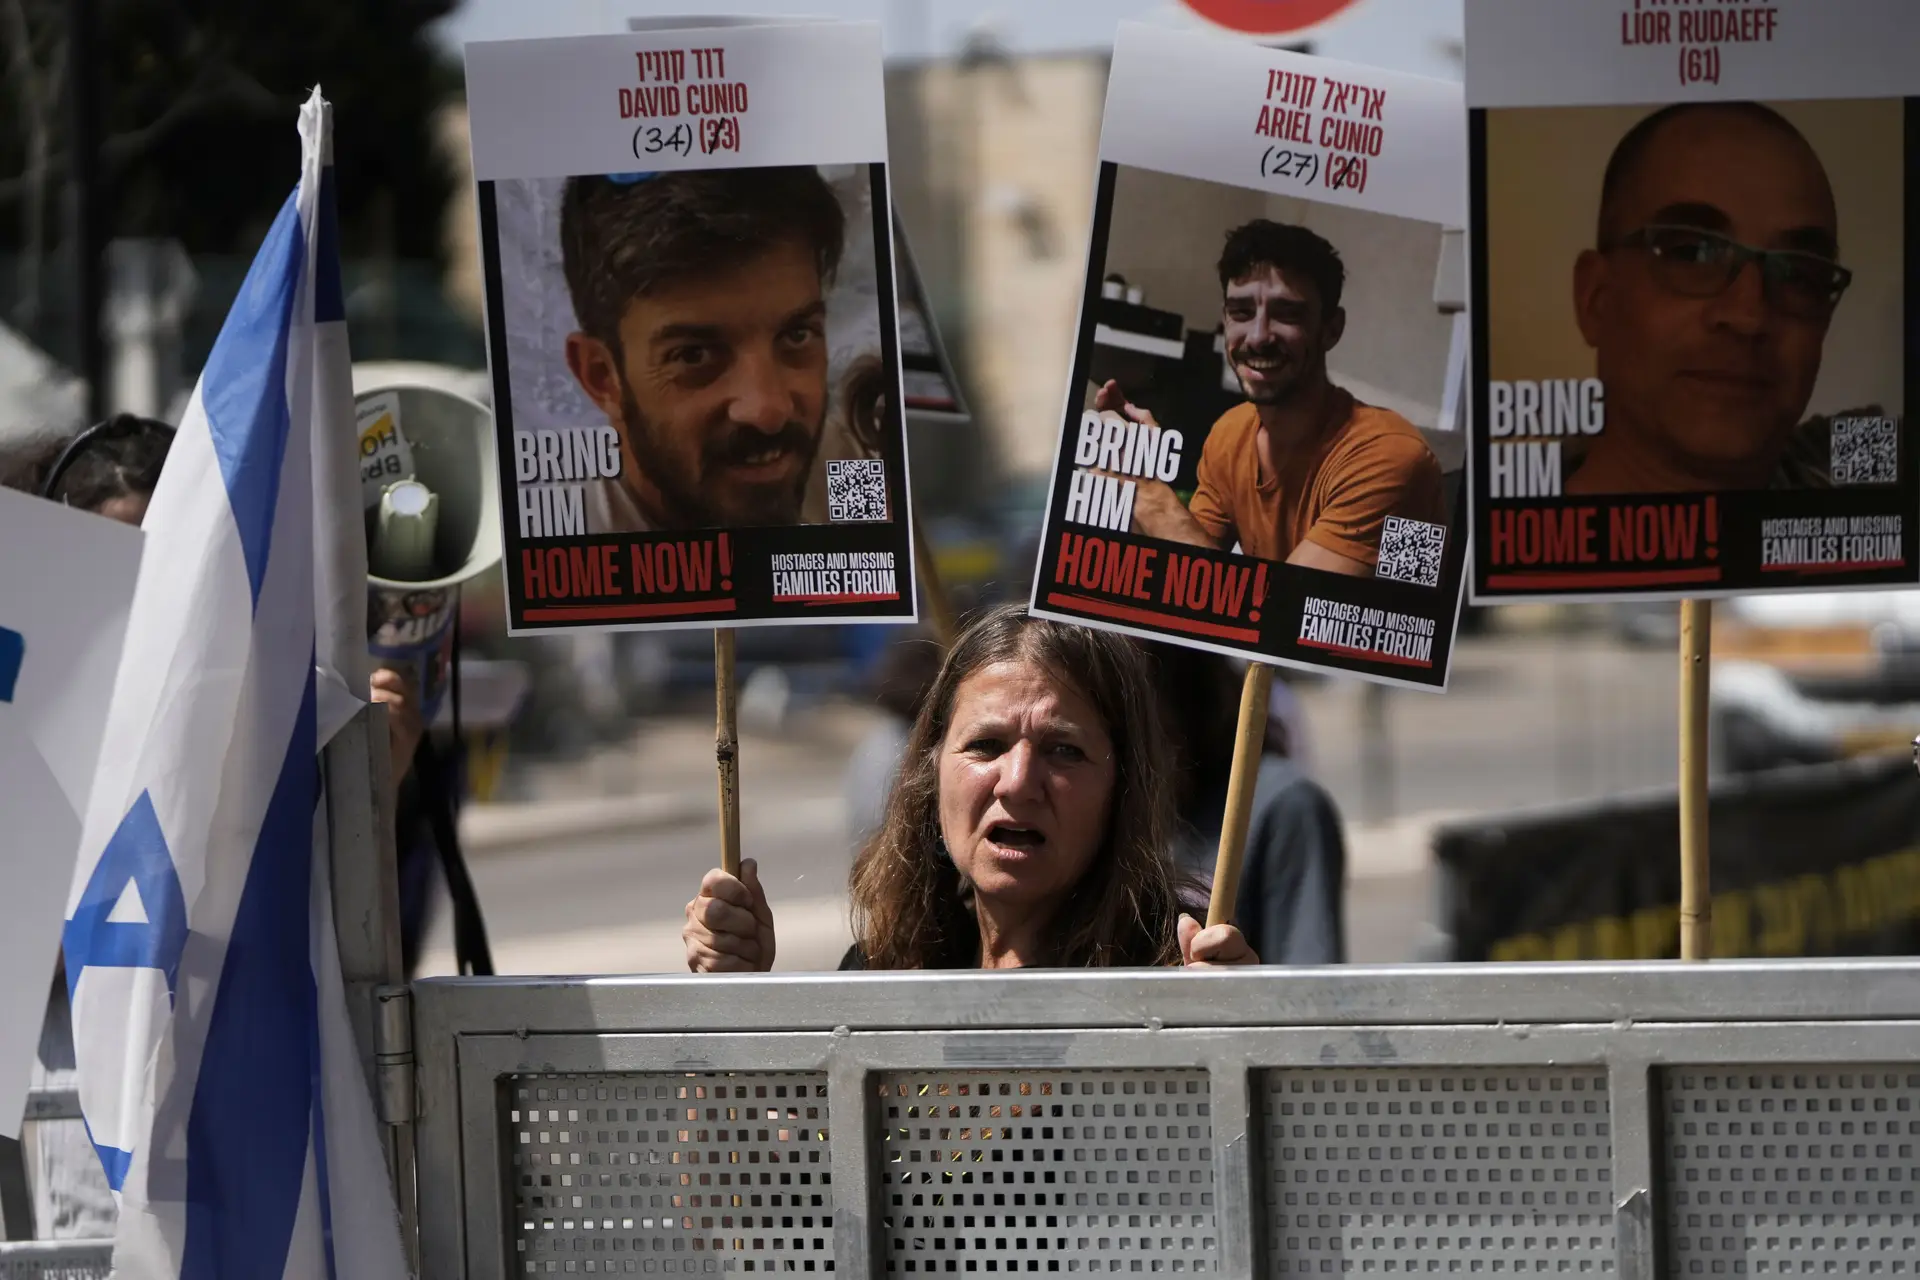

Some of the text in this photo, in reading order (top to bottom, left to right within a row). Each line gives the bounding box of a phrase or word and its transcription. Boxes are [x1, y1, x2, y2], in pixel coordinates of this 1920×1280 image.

[1622, 8, 1778, 45] LIOR RUDAEFF
[690, 48, 724, 79] דוד
[1679, 46, 1720, 86] (61)
[619, 82, 748, 119] DAVID CUNIO
[1322, 76, 1386, 121] אריאל
[632, 123, 693, 159] (34)
[1255, 104, 1383, 157] ARIEL CUNIO
[1261, 145, 1319, 186] (27)
[1489, 378, 1605, 437] BRING
[514, 426, 621, 483] BRING
[1074, 409, 1184, 483] BRING
[1489, 441, 1562, 498] HIM
[518, 484, 586, 539] HIM
[1064, 470, 1137, 533] HIM
[1490, 495, 1720, 566] HOME NOW!
[1761, 515, 1902, 538] HOSTAGES AND MISSING
[521, 532, 735, 600] HOME NOW!
[771, 551, 895, 571] HOSTAGES AND MISSING
[1762, 534, 1902, 565] FAMILIES FORUM
[772, 570, 896, 596] FAMILIES FORUM
[1055, 532, 1270, 622] HOME NOW!
[1300, 614, 1433, 663] FAMILIES FORUM
[1303, 596, 1436, 637] HOSTAGES AND MISSING
